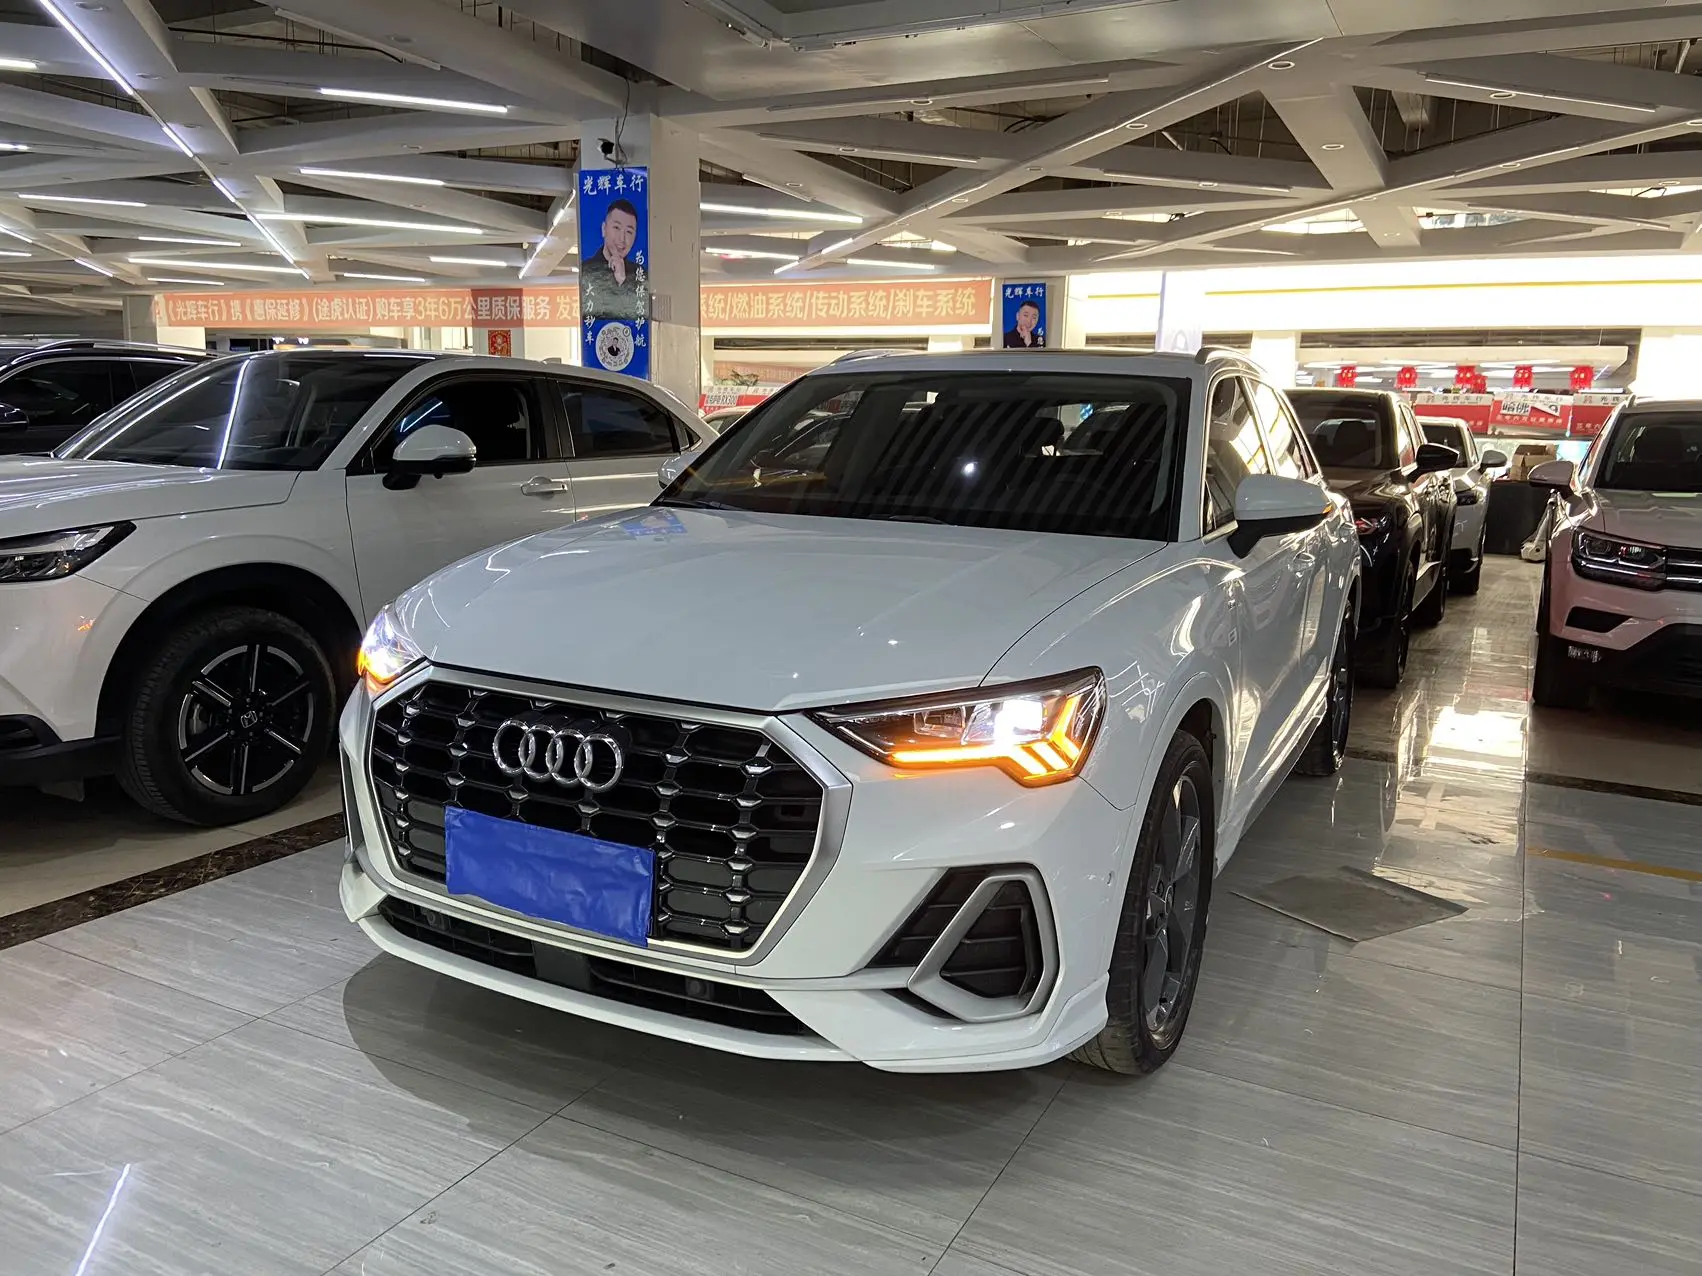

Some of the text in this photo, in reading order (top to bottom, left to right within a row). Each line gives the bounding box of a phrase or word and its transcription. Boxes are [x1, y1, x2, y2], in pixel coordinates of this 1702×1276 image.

[583, 175, 644, 196] 光辉车行
[635, 250, 647, 347] 为您保驾护航
[1005, 286, 1044, 299] 光辉车行
[1503, 402, 1530, 414] 哈佛
